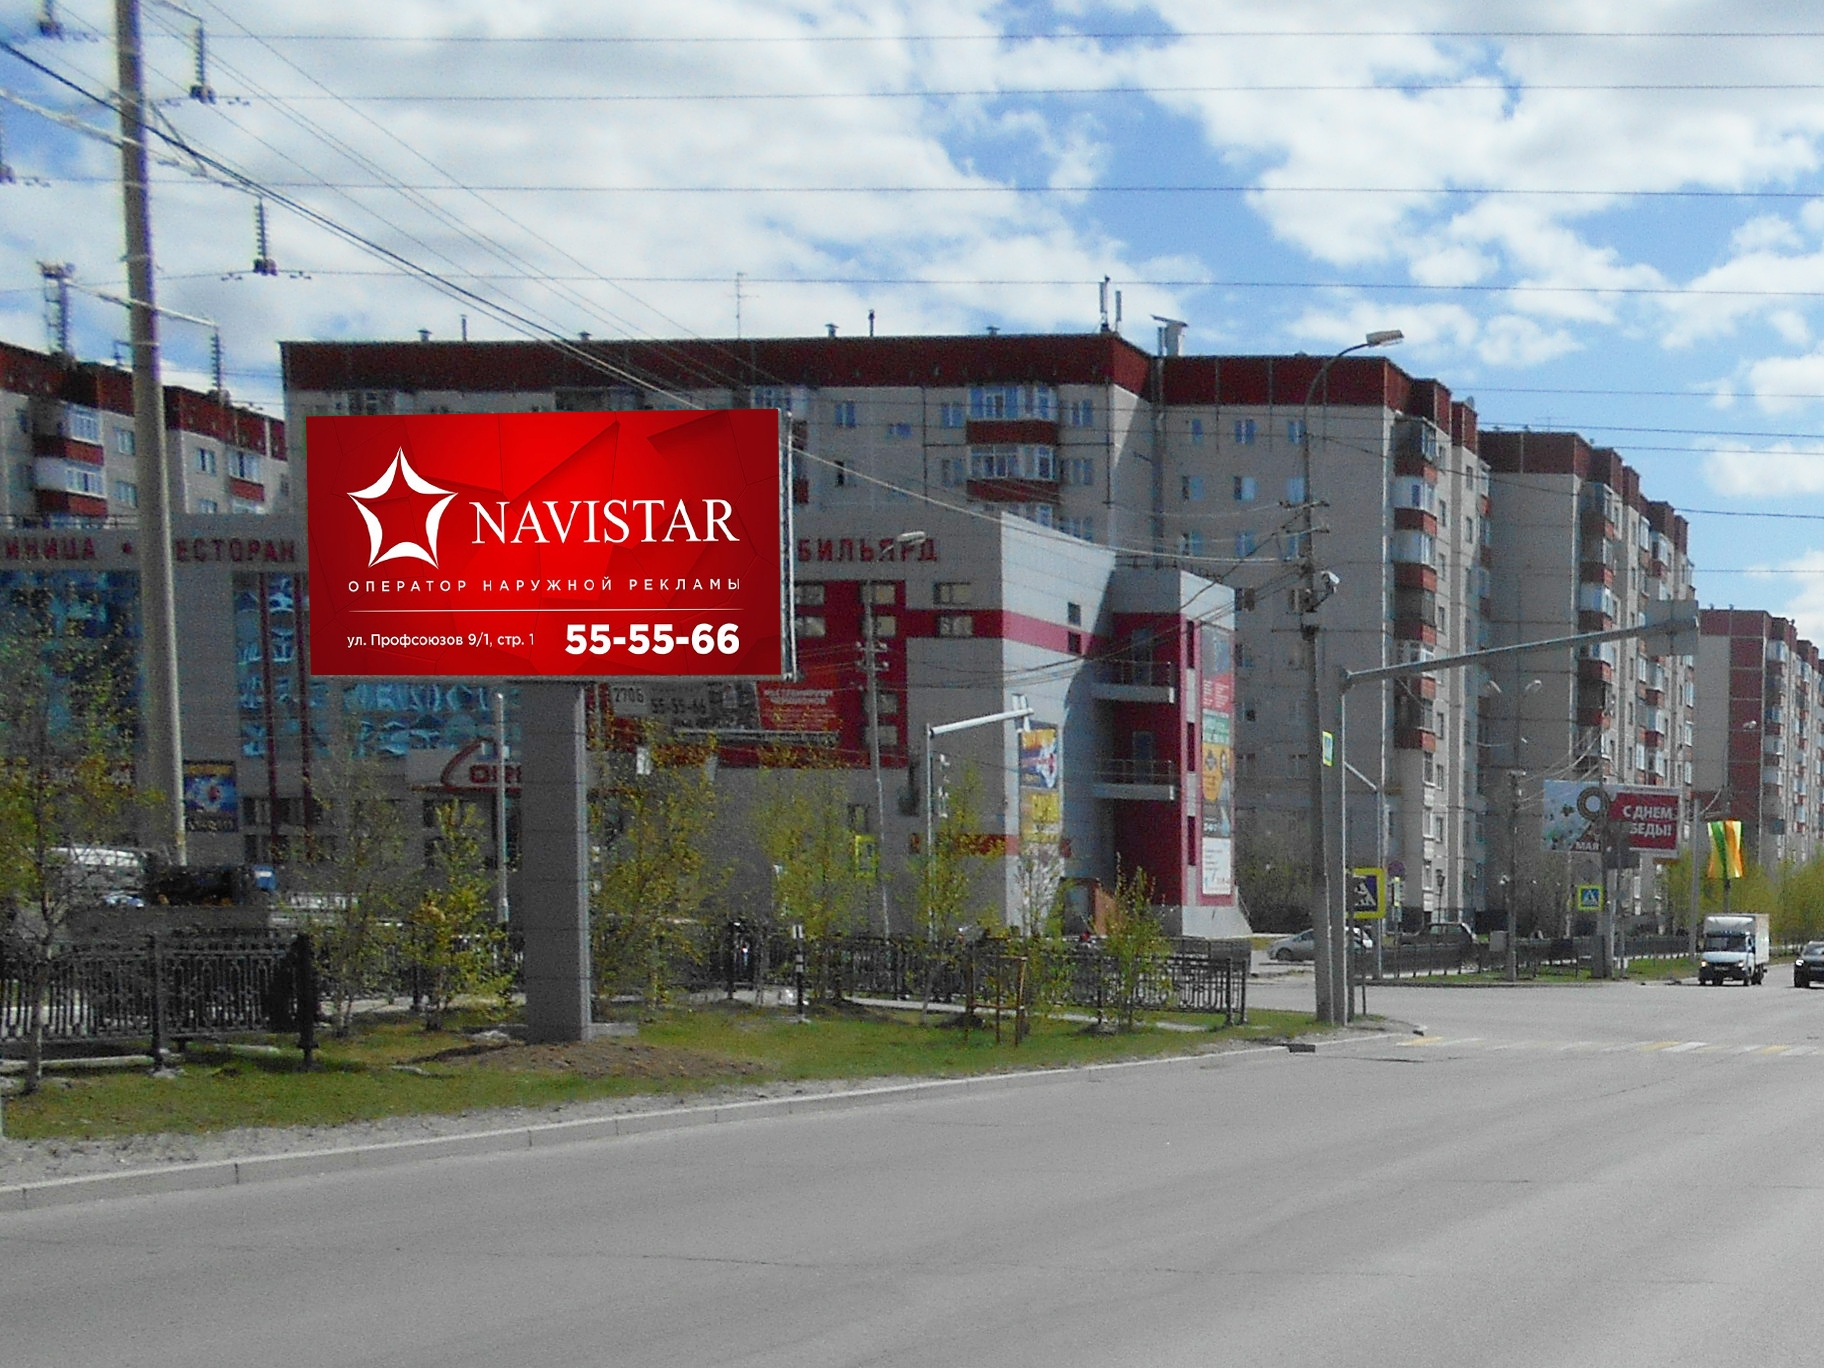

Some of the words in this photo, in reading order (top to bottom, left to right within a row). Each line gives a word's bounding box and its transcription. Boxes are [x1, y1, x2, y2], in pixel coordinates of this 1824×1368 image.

[469, 498, 740, 544] NAVISTAR
[175, 537, 296, 562] ЕСТОРАН
[348, 579, 467, 593] ОПЕРАТОР
[483, 575, 612, 592] НАРУЖНОЙ
[629, 578, 740, 591] РЕКЛАМЫ
[347, 634, 367, 648] ул.
[371, 632, 464, 649] Профсоюзов
[467, 632, 493, 648] 9/1,
[497, 635, 525, 649] стр.
[529, 634, 535, 646] 1
[565, 623, 740, 655] 55-55-66
[1623, 805, 1632, 818] С
[1632, 806, 1673, 821] ДНЕМ
[1575, 841, 1600, 850] МАЯ
